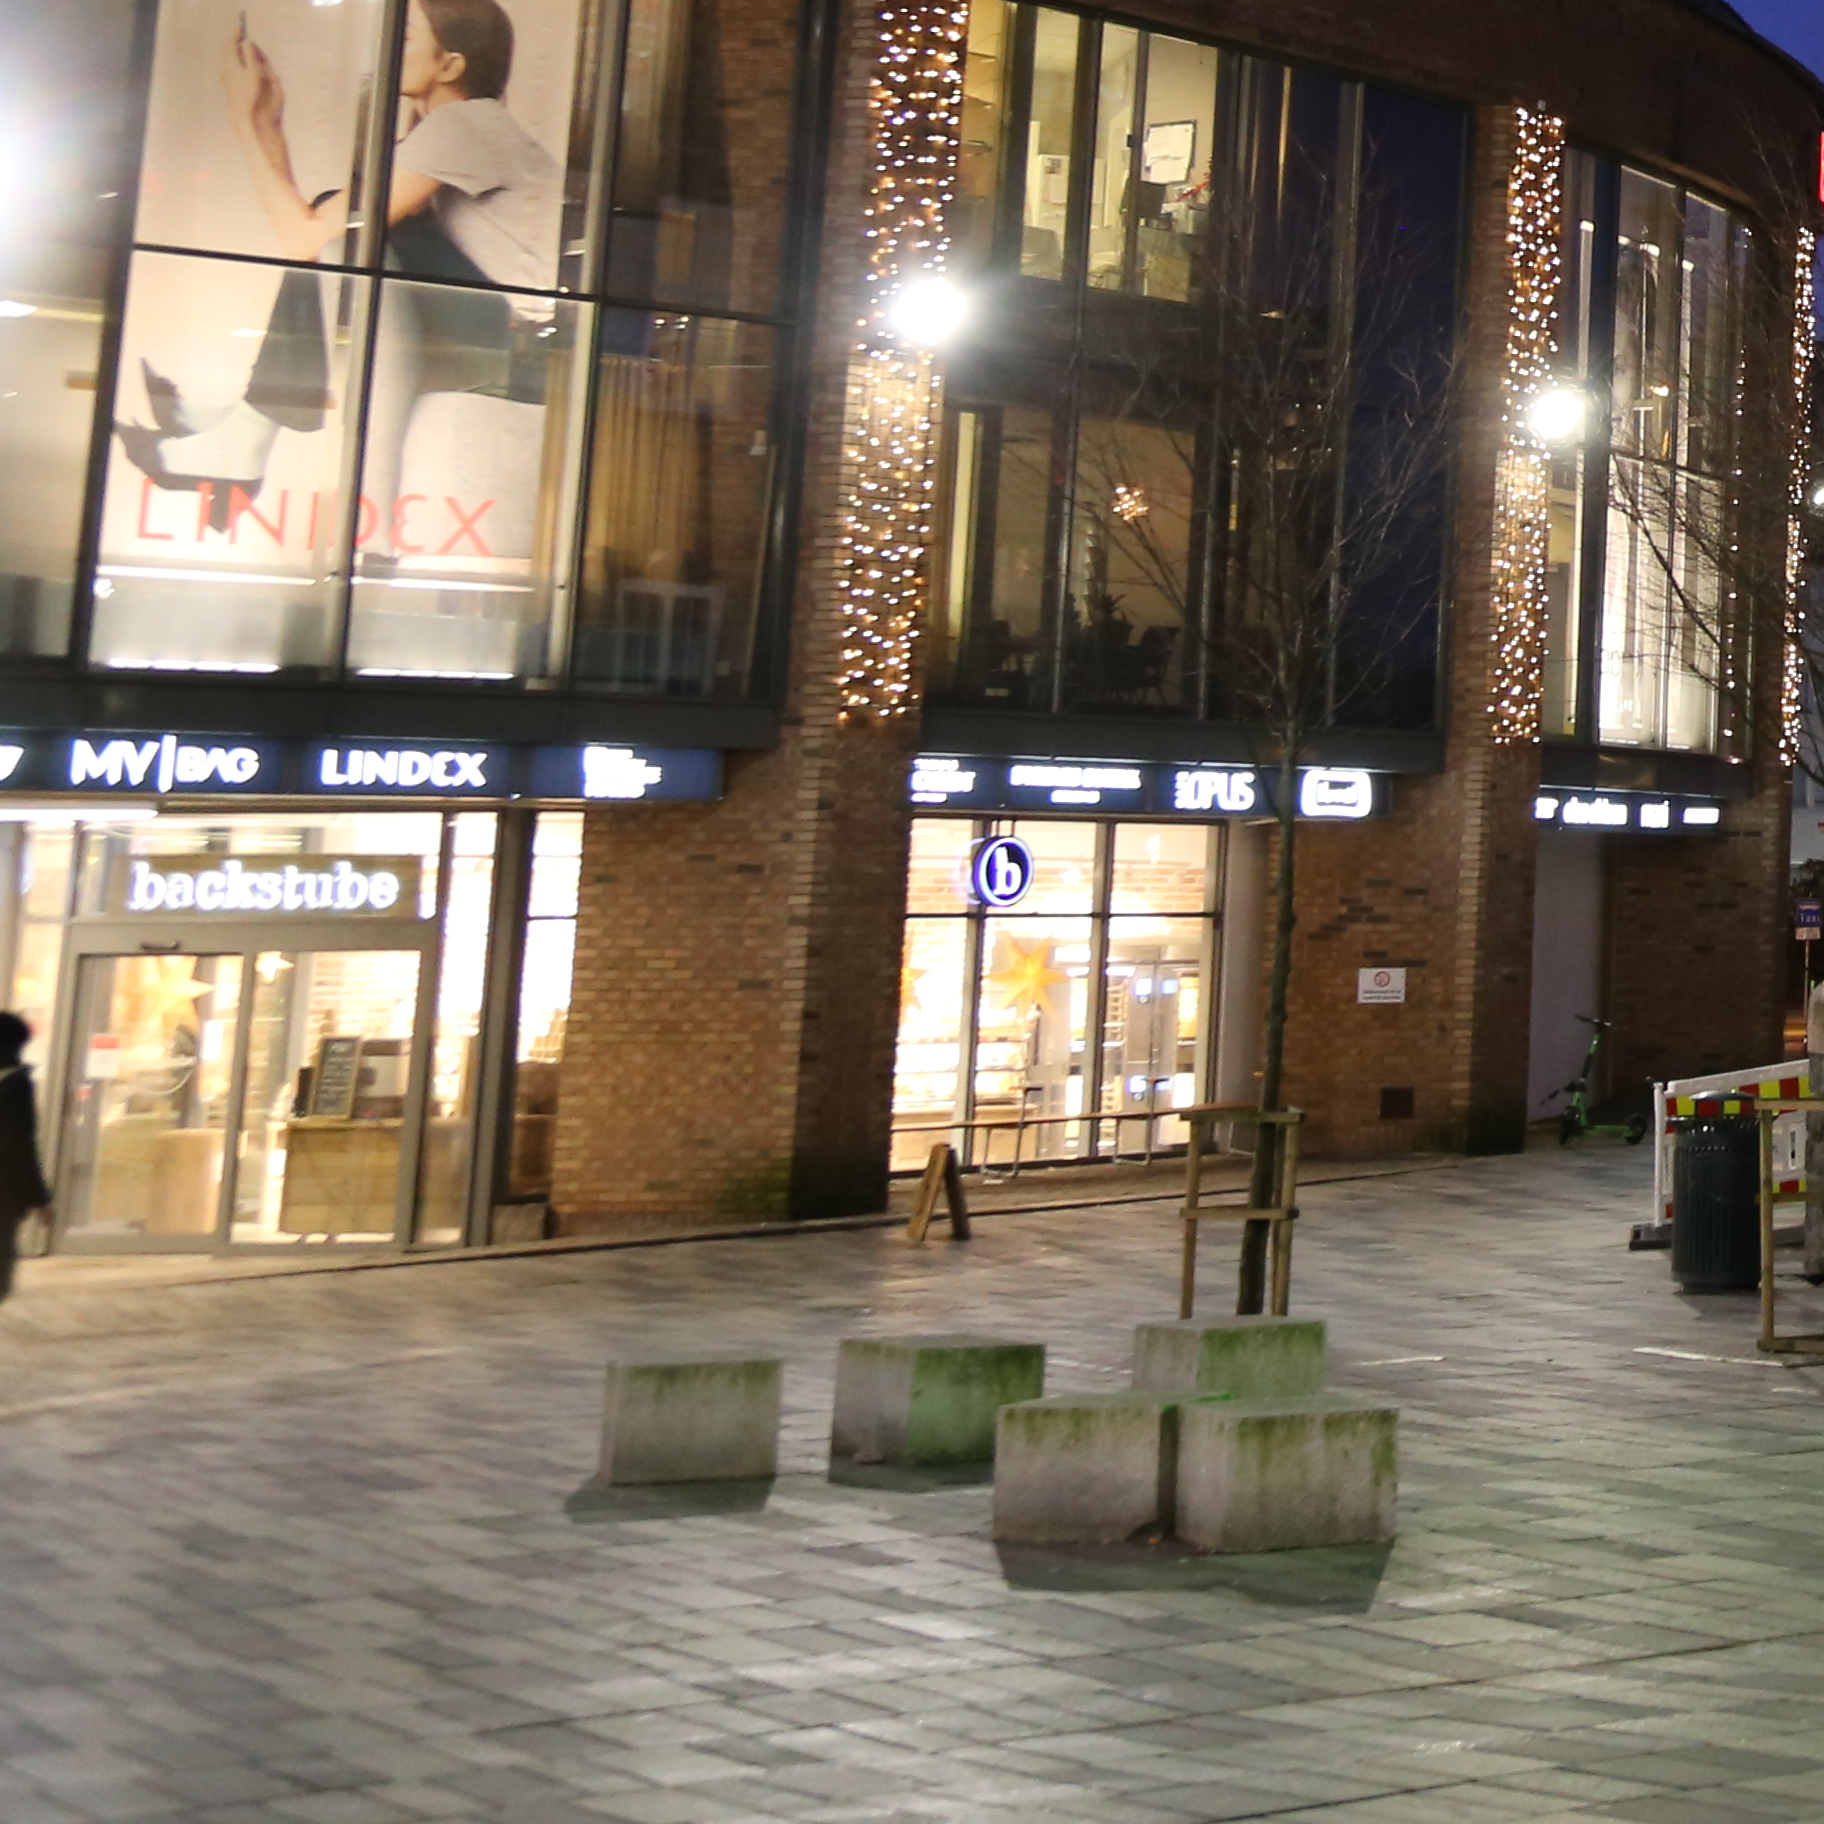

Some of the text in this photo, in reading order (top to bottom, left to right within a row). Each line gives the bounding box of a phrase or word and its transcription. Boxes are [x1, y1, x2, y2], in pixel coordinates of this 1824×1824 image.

[137, 477, 497, 559] LINDEX
[321, 749, 488, 788] LINDEX
[128, 860, 400, 911] backstube
